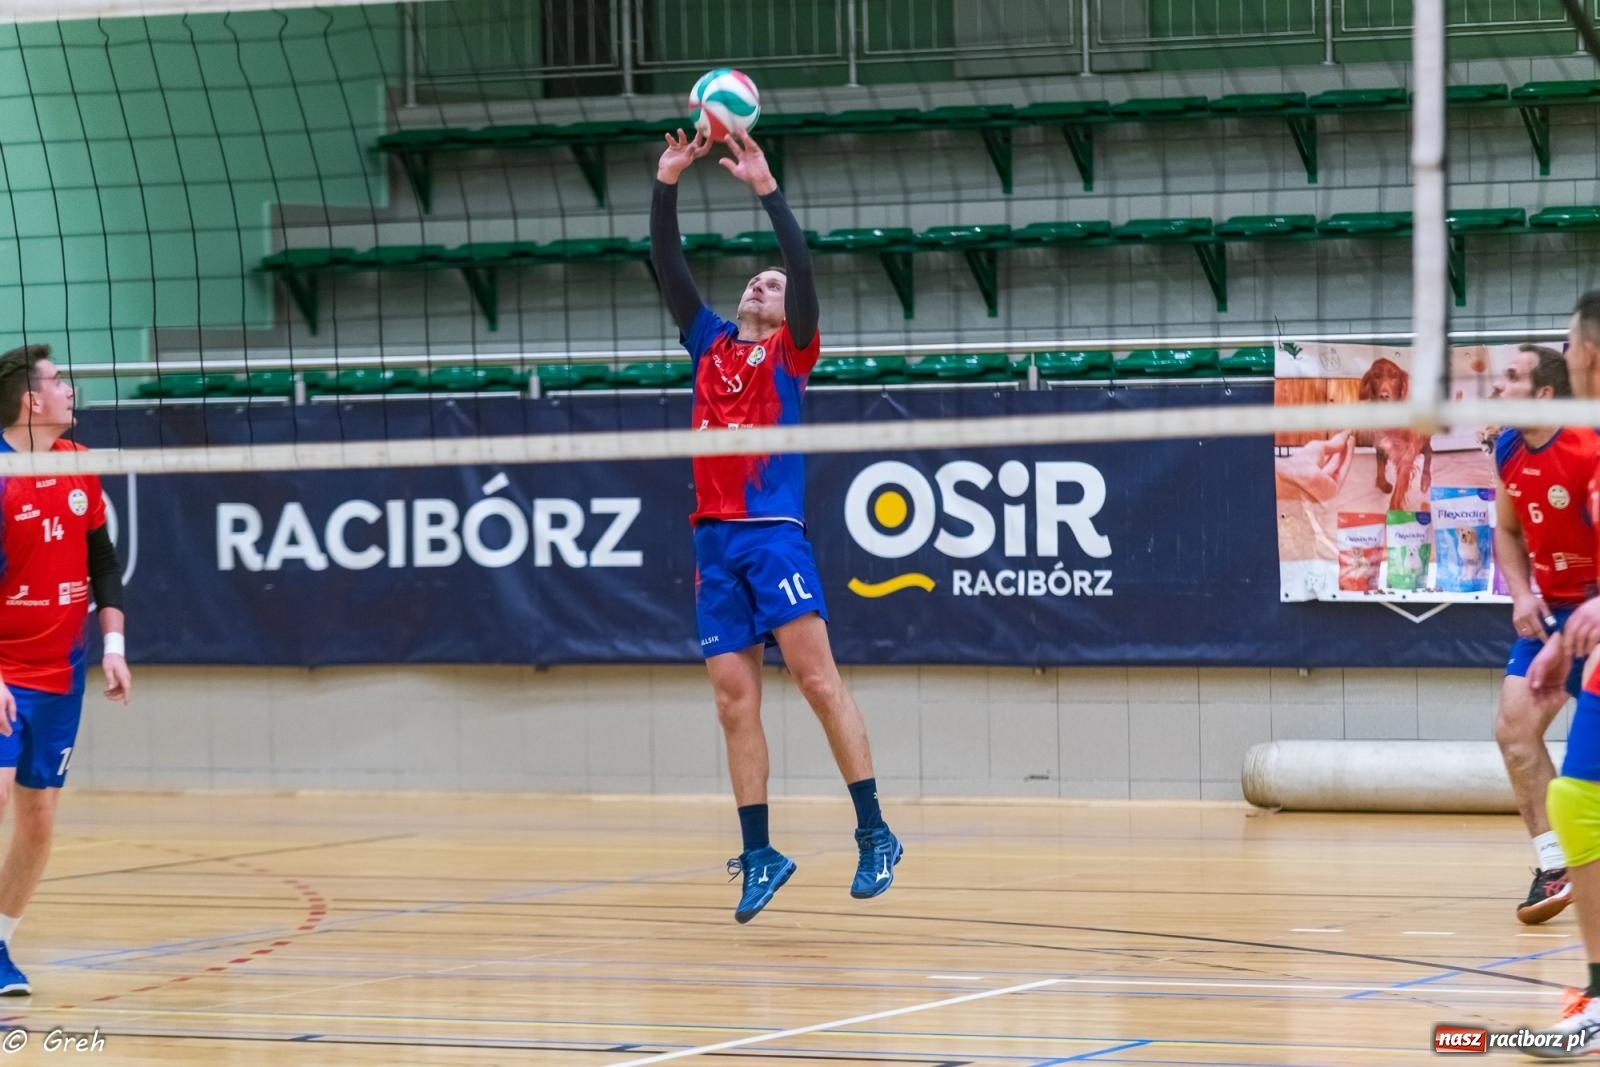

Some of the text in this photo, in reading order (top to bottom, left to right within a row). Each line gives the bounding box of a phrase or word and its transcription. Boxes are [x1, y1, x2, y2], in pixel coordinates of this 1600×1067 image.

[216, 472, 643, 571] RACIBÓRZ
[1527, 502, 1544, 524] 6
[42, 516, 64, 543] 14
[777, 572, 812, 606] 10
[953, 561, 1113, 596] RACIBÓRZ
[56, 747, 73, 776] 1
